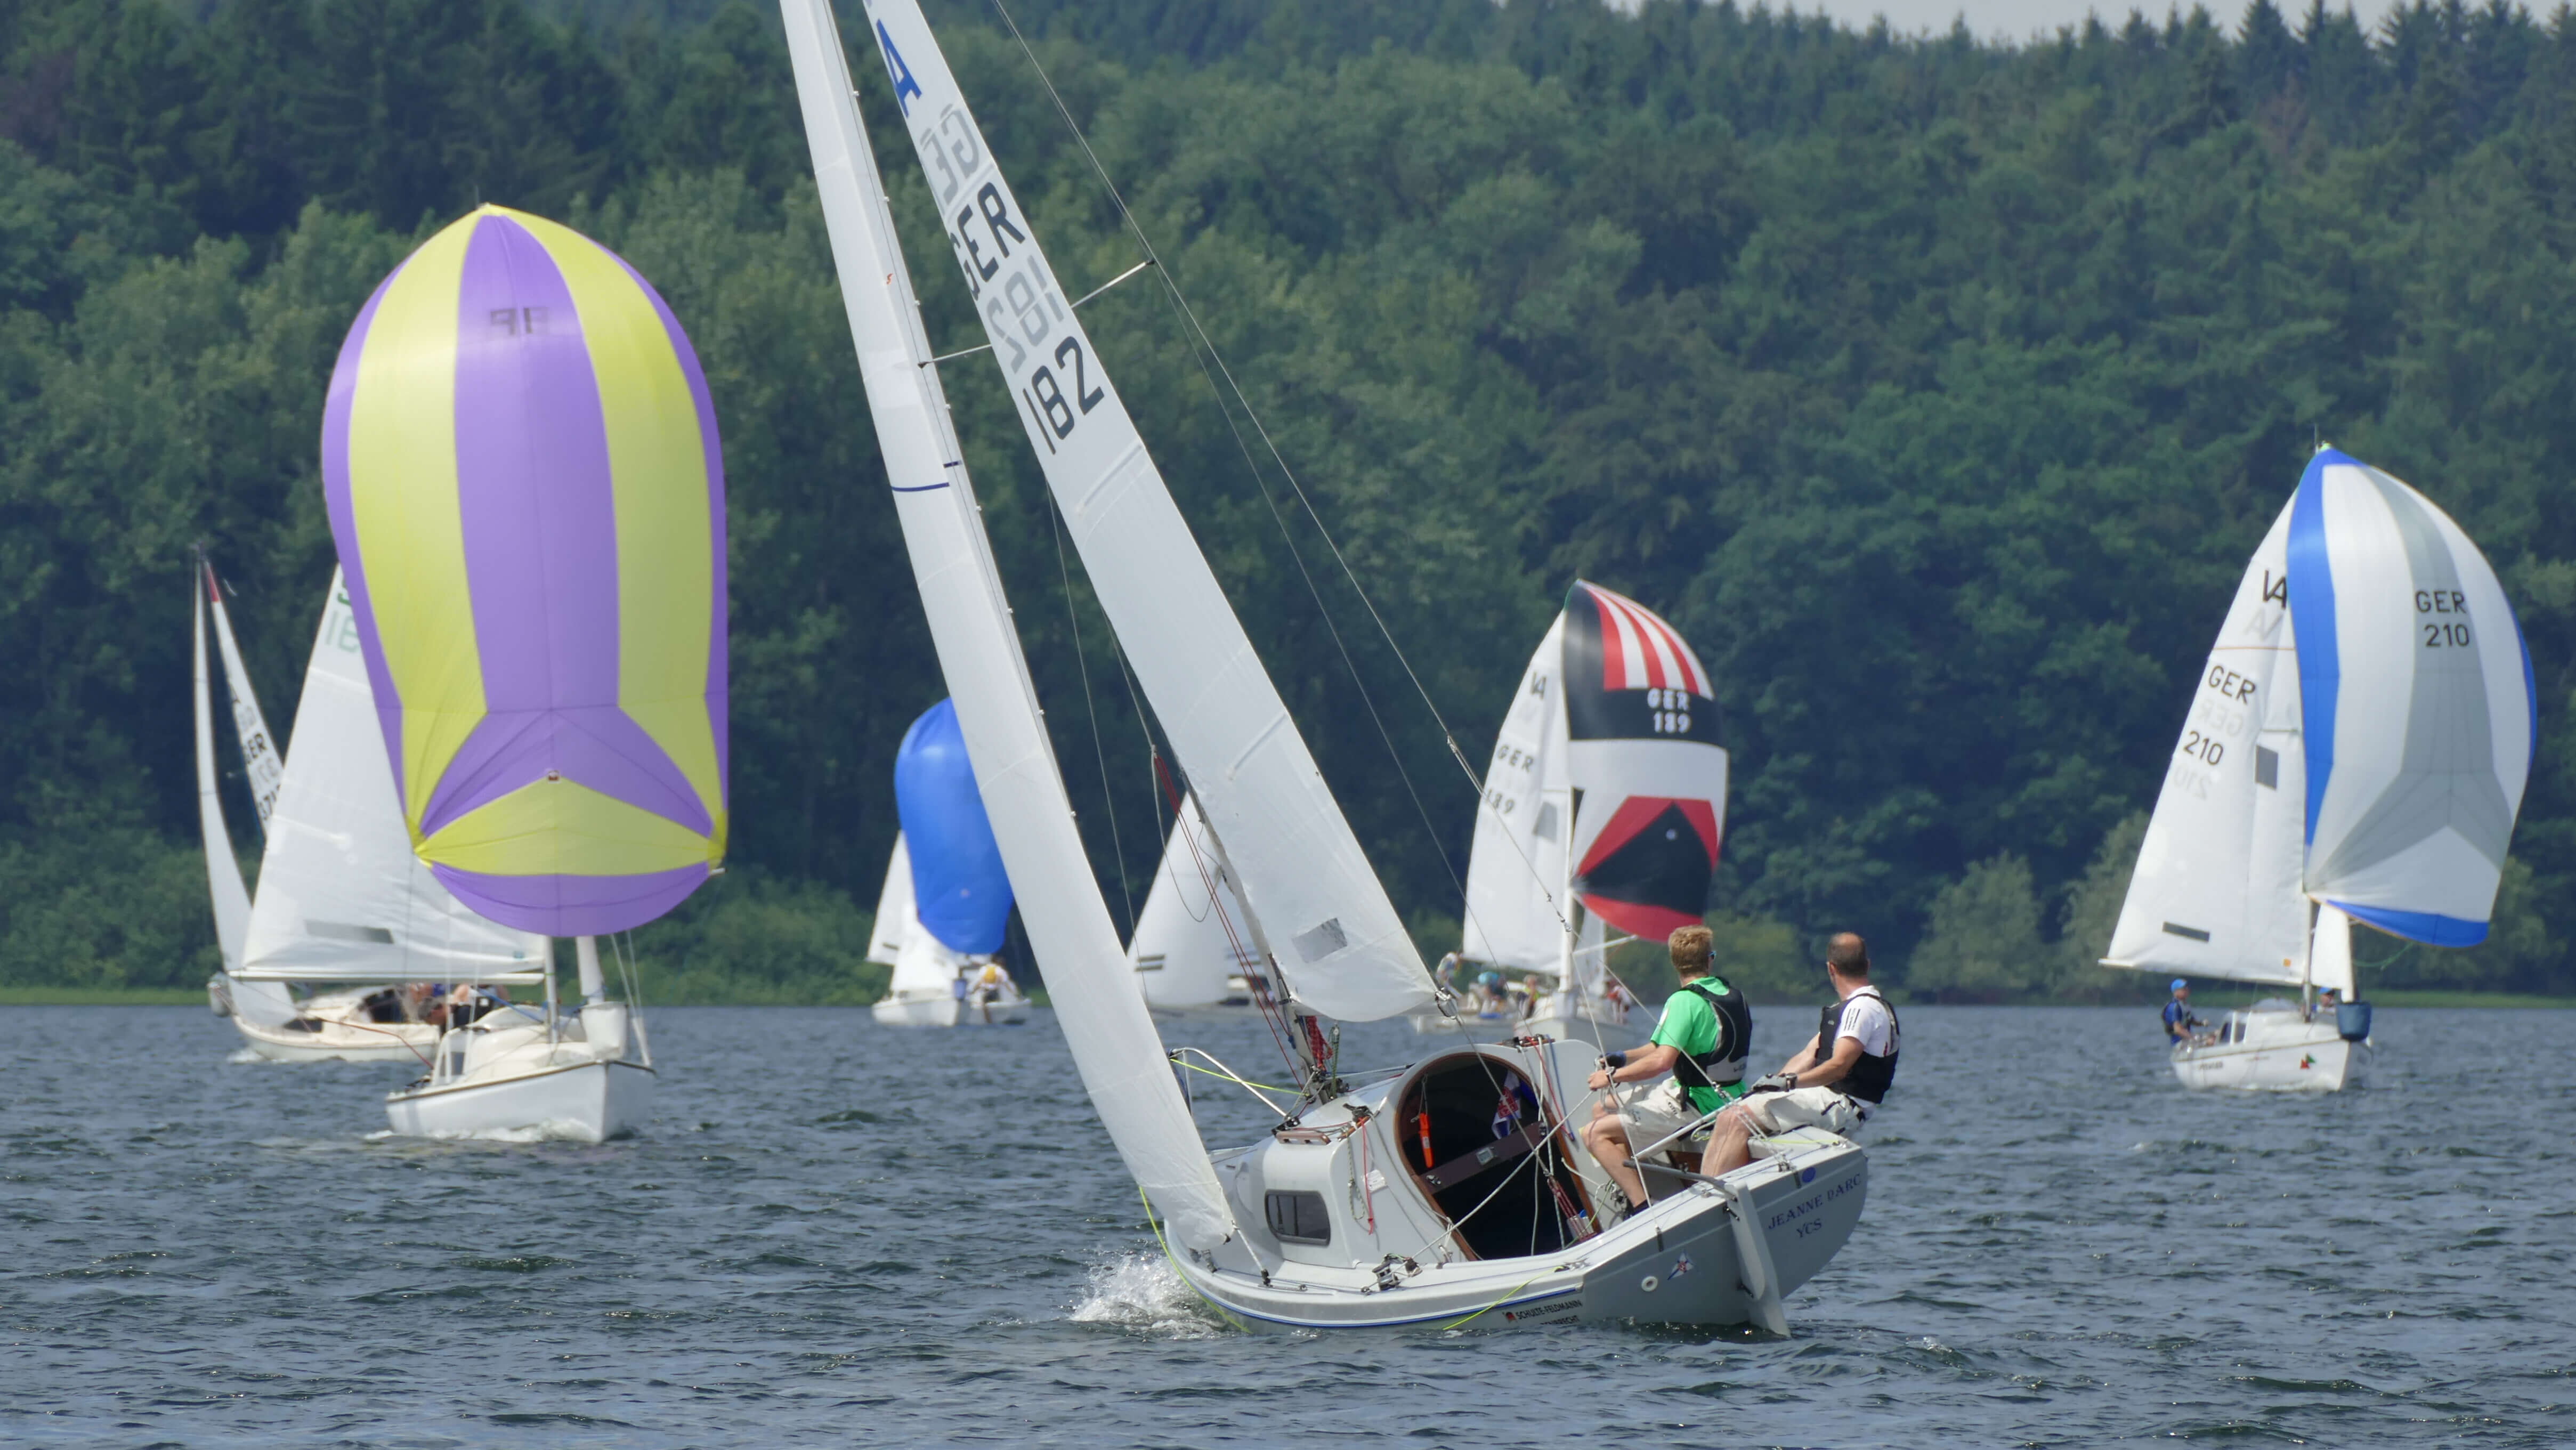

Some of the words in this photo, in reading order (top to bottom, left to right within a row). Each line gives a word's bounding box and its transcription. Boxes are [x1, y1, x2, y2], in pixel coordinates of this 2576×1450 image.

[1022, 336, 1105, 456] 182
[2415, 590, 2467, 613] GER
[2424, 623, 2470, 647] 210
[2208, 665, 2256, 705] GER
[1647, 688, 1689, 711] GER
[1654, 711, 1692, 733] 189
[1497, 744, 1534, 773] GER
[2183, 731, 2224, 766] 210
[1768, 1194, 1823, 1230] JEANNE
[1796, 1218, 1822, 1239] YCS
